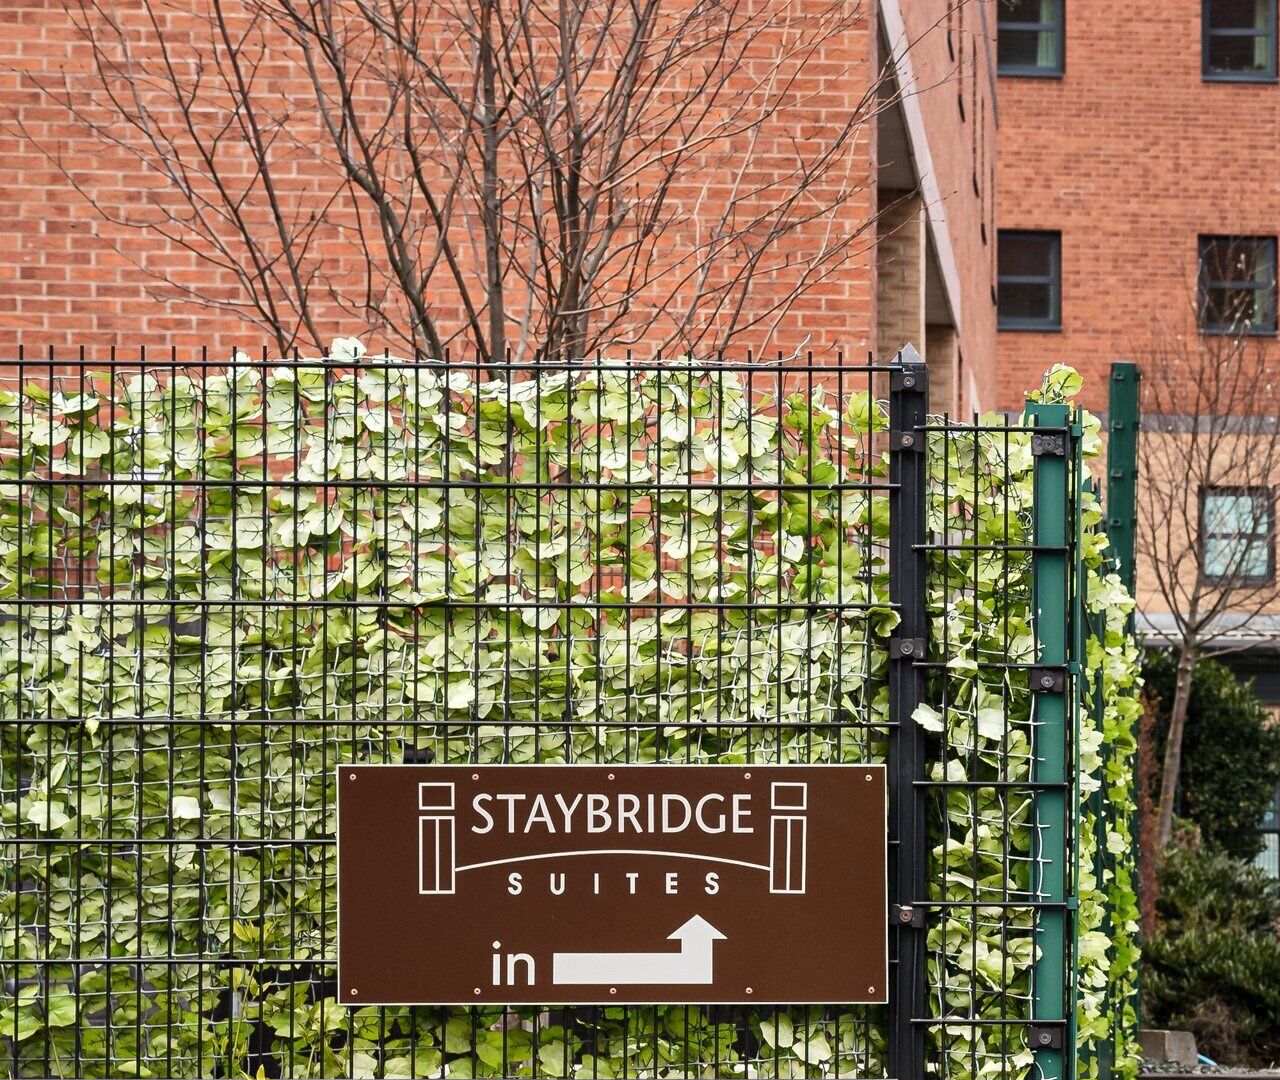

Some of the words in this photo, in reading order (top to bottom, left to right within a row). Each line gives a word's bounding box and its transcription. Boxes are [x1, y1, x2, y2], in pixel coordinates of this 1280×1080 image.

[471, 792, 754, 835] STAYBRIDGE
[507, 872, 720, 896] SUITES
[492, 940, 536, 986] in
